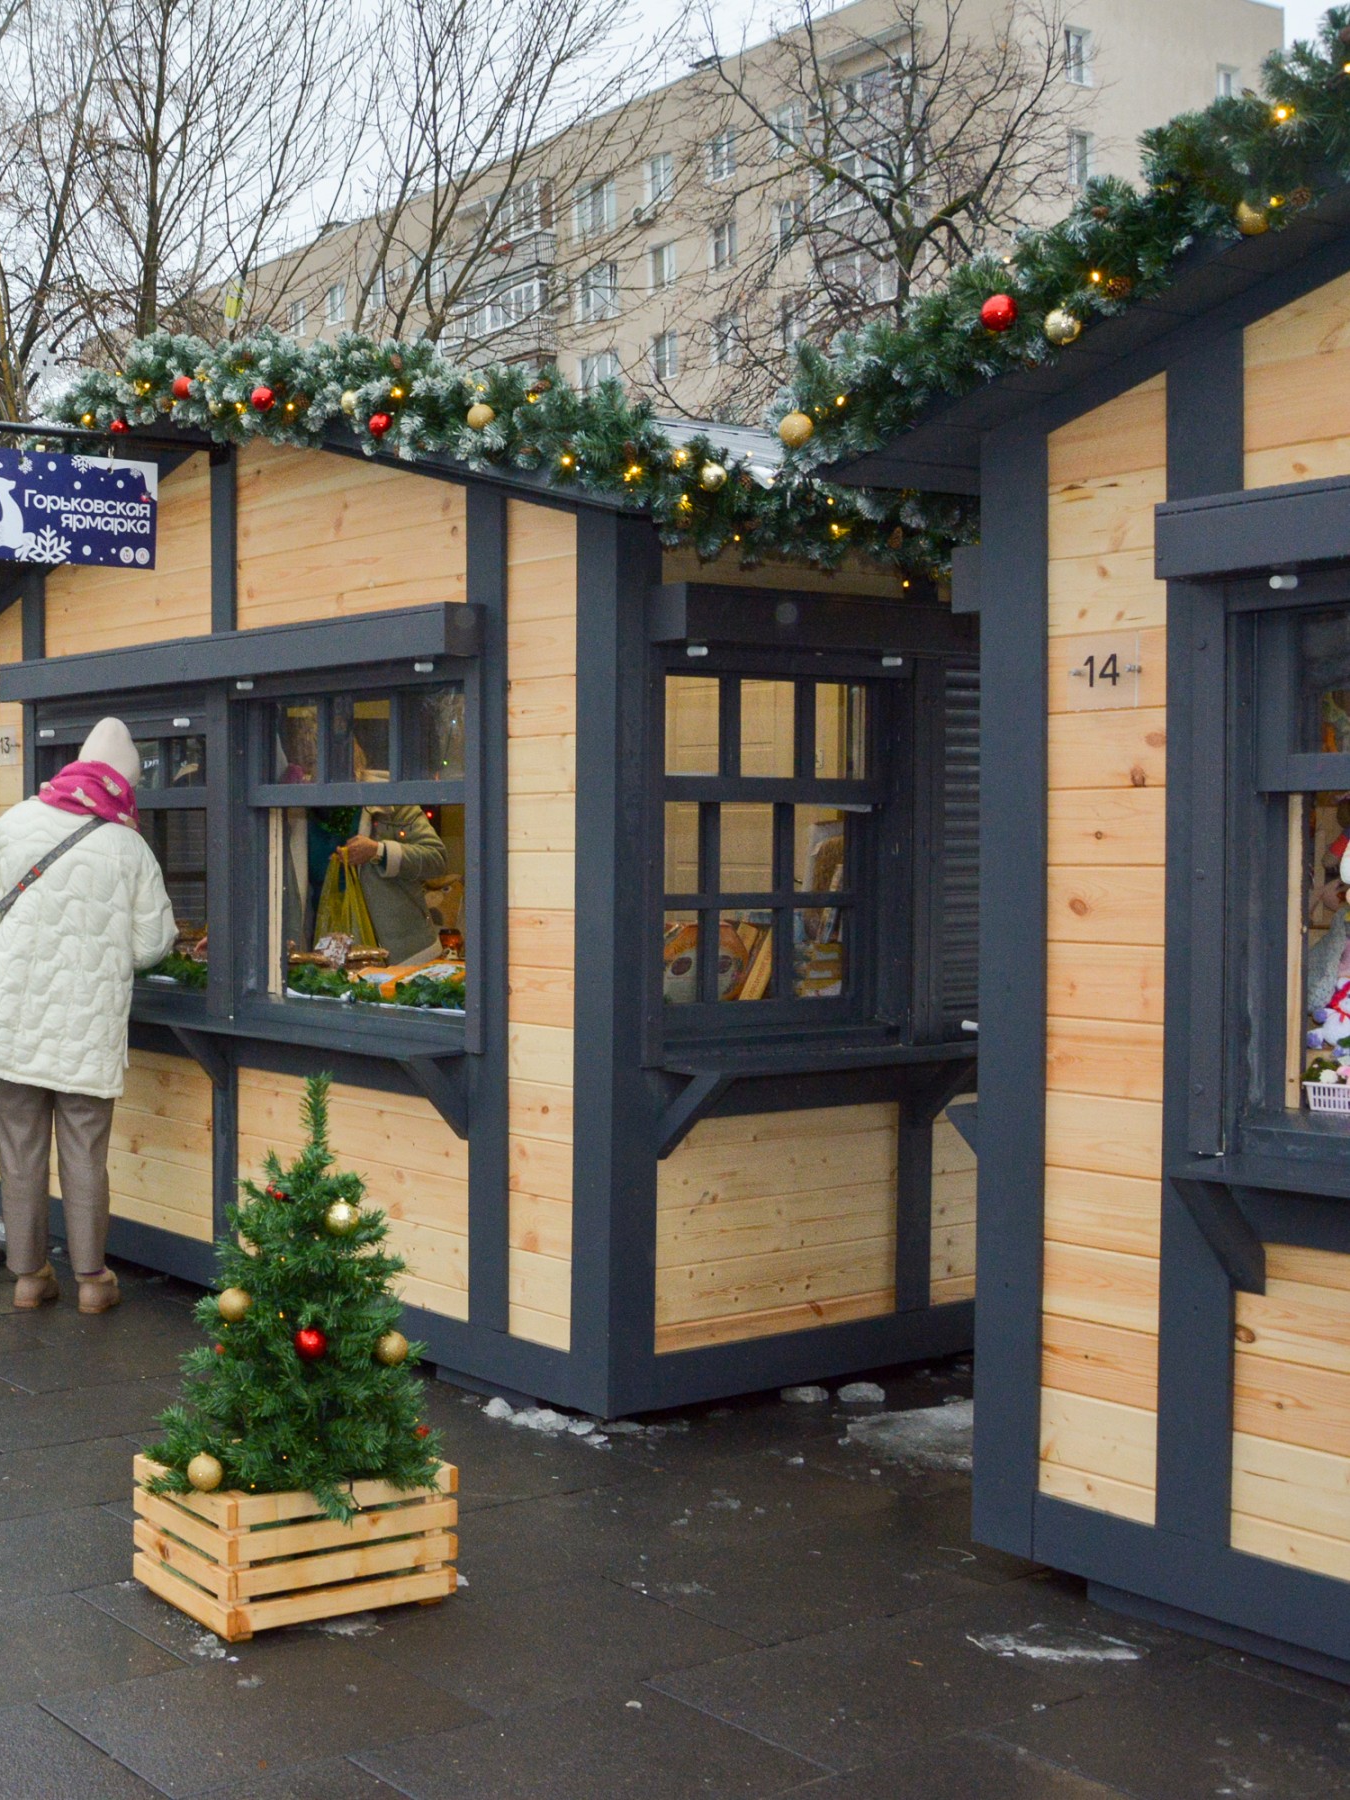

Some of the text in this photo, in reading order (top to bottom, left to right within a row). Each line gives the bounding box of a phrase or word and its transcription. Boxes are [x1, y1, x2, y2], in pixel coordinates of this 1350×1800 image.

[24, 489, 151, 518] Горьковская
[61, 513, 151, 535] ярмарка
[1083, 653, 1120, 688] 14
[0, 736, 11, 755] 13
